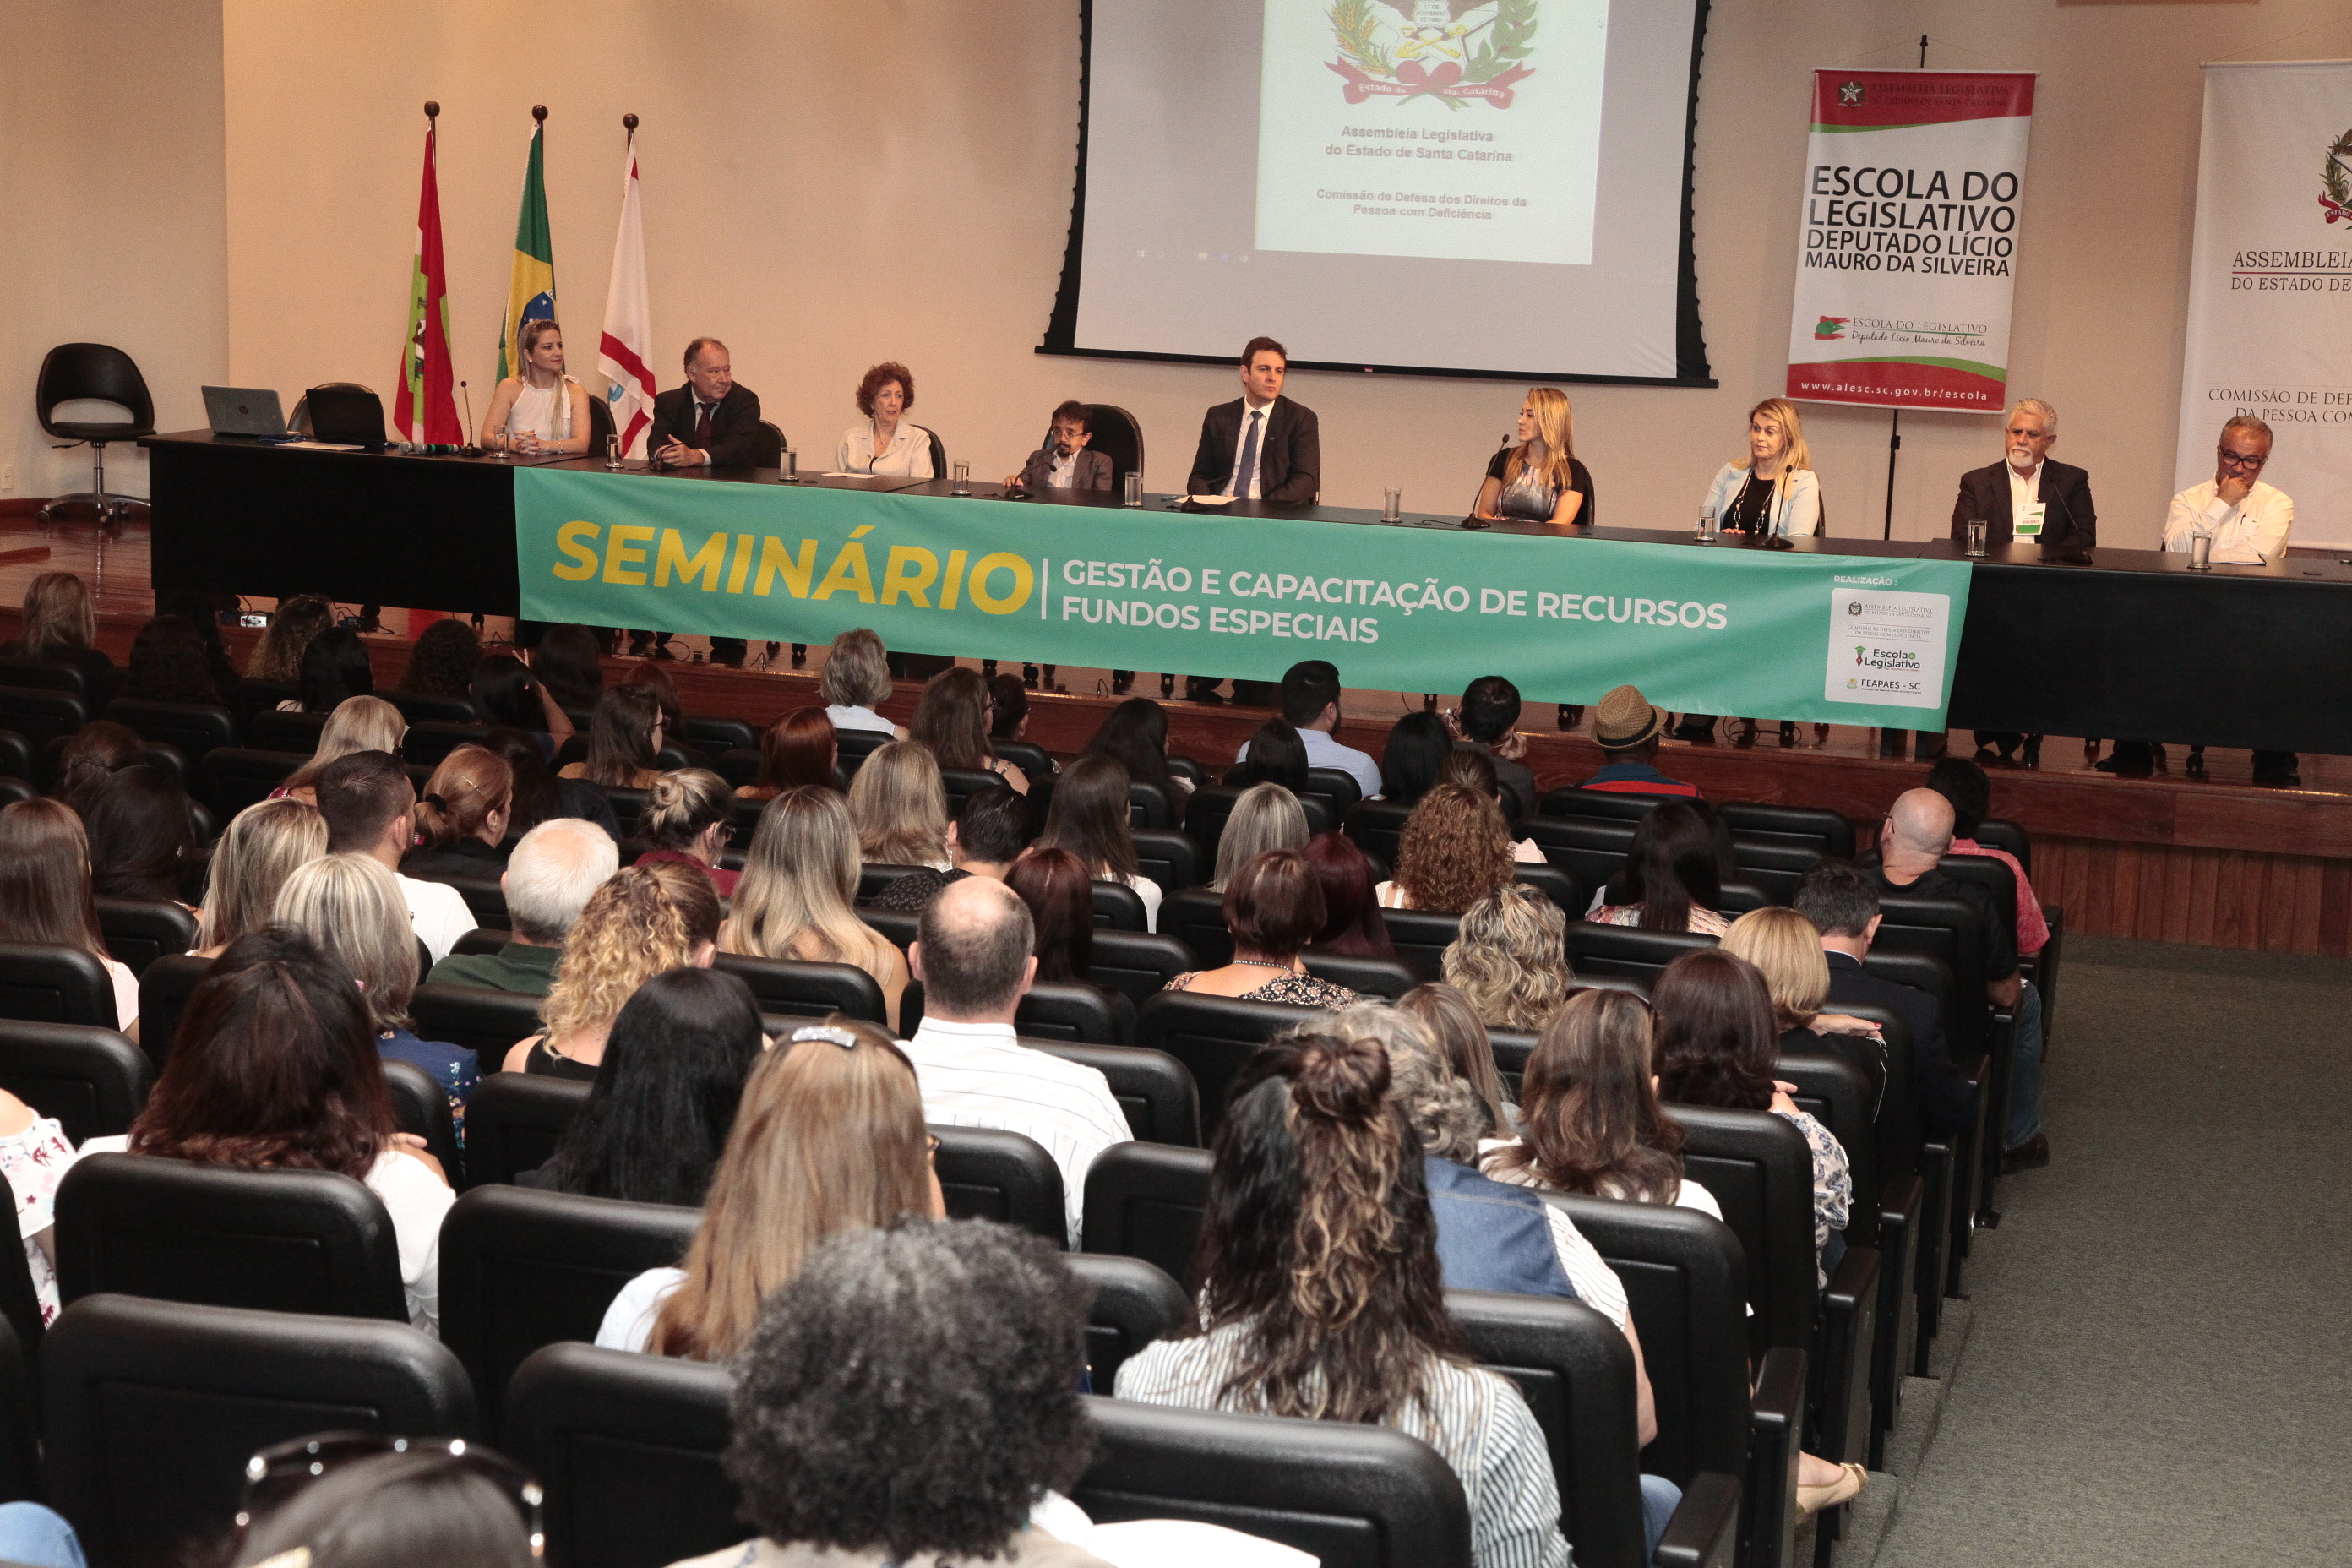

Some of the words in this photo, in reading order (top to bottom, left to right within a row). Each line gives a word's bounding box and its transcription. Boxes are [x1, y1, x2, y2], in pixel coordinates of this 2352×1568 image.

[1358, 83, 1392, 93] Estado
[1462, 87, 1505, 99] Catarina
[1342, 126, 1417, 139] Assembleia
[1422, 128, 1494, 143] Legislativa
[1324, 144, 1342, 155] do
[1346, 144, 1391, 157] Estado
[1396, 146, 1412, 158] de
[1416, 147, 1452, 160] Santa
[1457, 149, 1512, 162] Catarina
[1811, 166, 1950, 200] ESCOLA
[1962, 171, 2018, 203] DO
[1315, 188, 1374, 201] Comissão
[1377, 191, 1391, 202] de
[1395, 192, 1435, 204] Defesa
[1438, 193, 1461, 204] dos
[1464, 194, 1508, 207] Direitos
[1512, 196, 1527, 208] da
[1353, 204, 1396, 216] Pessoa
[1399, 207, 1424, 217] com
[1428, 206, 1492, 220] Deficiência
[1809, 199, 2016, 233] LEGISLATIVO
[2326, 210, 2350, 218] ESTADO
[1806, 229, 1941, 254] DEPUTADO
[1948, 231, 2013, 258] LÍCIO
[1805, 251, 1881, 271] MAURO
[1886, 255, 1915, 272] DA
[1921, 256, 2010, 276] SILVEIRA
[2231, 277, 2253, 291] DO
[2258, 277, 2323, 291] ESTADO
[2329, 278, 2352, 291] DE
[1853, 318, 1892, 329] ESCOLA
[1897, 320, 1914, 330] DO
[1918, 321, 1988, 334] LEGISLATIVO
[1851, 330, 1888, 345] Deputado
[1914, 334, 1940, 344] Mauro
[1941, 335, 1952, 345] da
[1954, 334, 1986, 346] Silveira
[1801, 382, 1988, 401] www.alesc.sc.gov.br/escola
[2208, 388, 2291, 403] COMISSÃO
[2297, 391, 2317, 405] DE
[2262, 408, 2317, 422] PESSOA
[552, 520, 1034, 615] SEMINÁRIO
[1834, 575, 1892, 586] REALIZAÇÃO
[1063, 558, 1192, 592] GESTÃO
[1201, 569, 1221, 595] E
[1229, 571, 1470, 616] CAPACITAÇÃO
[1480, 588, 1527, 616] DE
[1537, 592, 1728, 630] RECURSOS
[1062, 596, 1200, 631] FUNDOS
[1209, 607, 1379, 644] ESPECIAIS
[1873, 649, 1908, 659] Escola
[1865, 657, 1920, 669] Legislativo
[1861, 679, 1900, 689] FEAPAES
